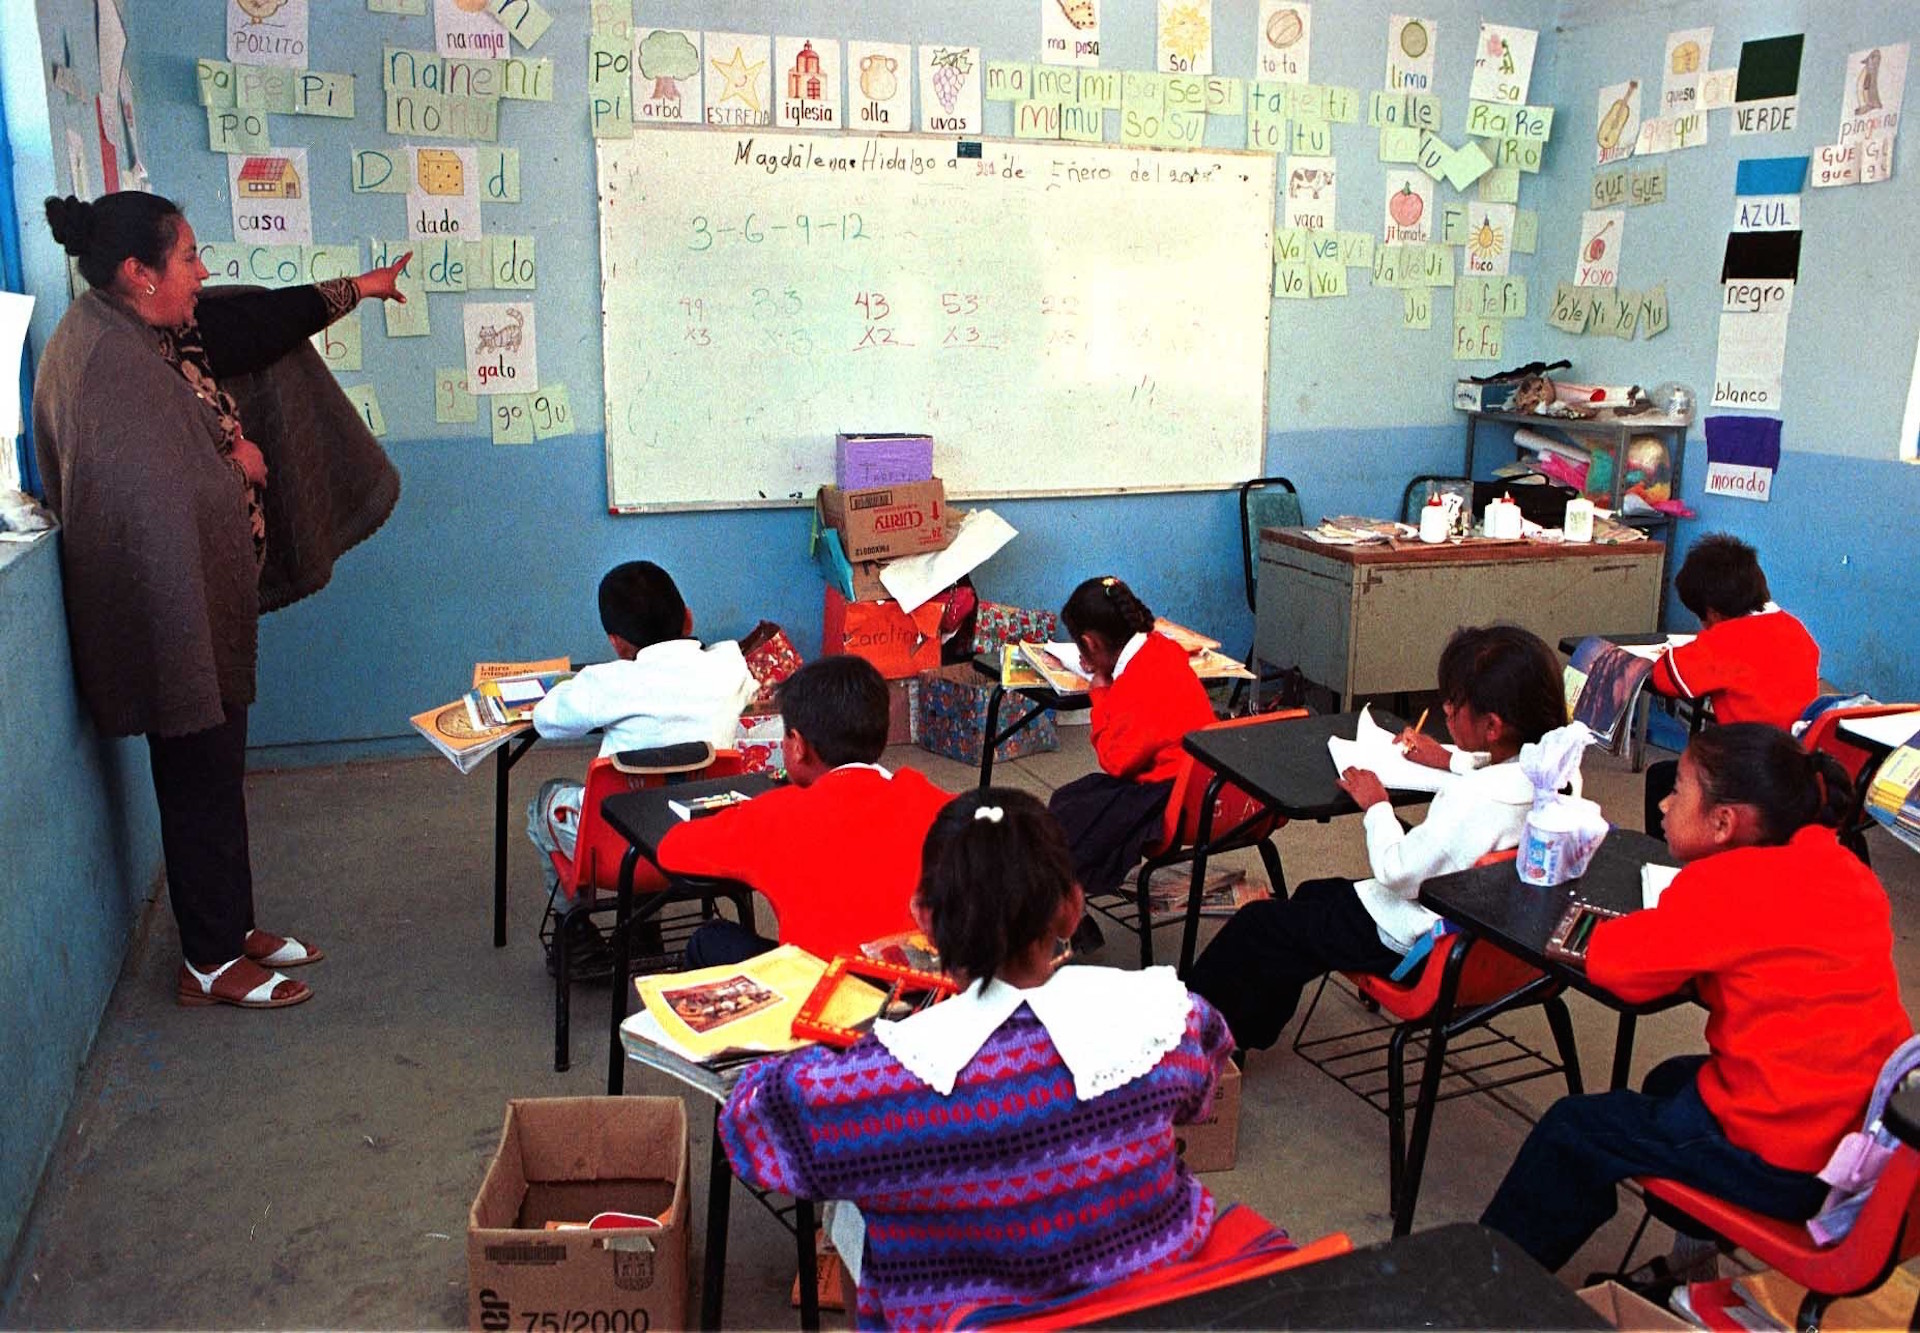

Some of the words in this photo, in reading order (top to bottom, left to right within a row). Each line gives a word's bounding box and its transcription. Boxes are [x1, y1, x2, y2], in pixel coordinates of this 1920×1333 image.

[233, 31, 304, 54] POLLITO
[446, 29, 504, 58] naranja
[391, 51, 438, 90] na
[448, 61, 493, 96] ne
[503, 58, 541, 97] ni
[988, 67, 1023, 90] ma
[1039, 70, 1074, 95] me
[1083, 74, 1113, 102] mi
[860, 101, 890, 124] olla
[1252, 85, 1282, 114] ta
[1375, 95, 1397, 122] la
[784, 102, 833, 126] iglesia
[930, 115, 967, 132] uvas
[1471, 105, 1506, 131] Ra
[1514, 108, 1544, 136] Re
[1737, 106, 1796, 131] VERDE
[1504, 138, 1538, 164] Ro
[356, 150, 394, 189] D
[487, 152, 509, 198] d
[237, 212, 286, 231] casa
[416, 208, 461, 234] dado
[1293, 212, 1324, 231] vaca
[1444, 210, 1462, 240] F
[1739, 202, 1792, 227] AZUL
[429, 240, 464, 286] de
[499, 240, 535, 285] do
[1469, 253, 1494, 272] foco
[854, 291, 891, 320] 43
[941, 292, 979, 315] 53
[1727, 284, 1785, 312] negro
[1714, 381, 1769, 402] blanco
[497, 403, 523, 431] go
[1711, 471, 1766, 493] morado
[874, 510, 924, 531] CURITY
[521, 1308, 650, 1332] 75/2000
